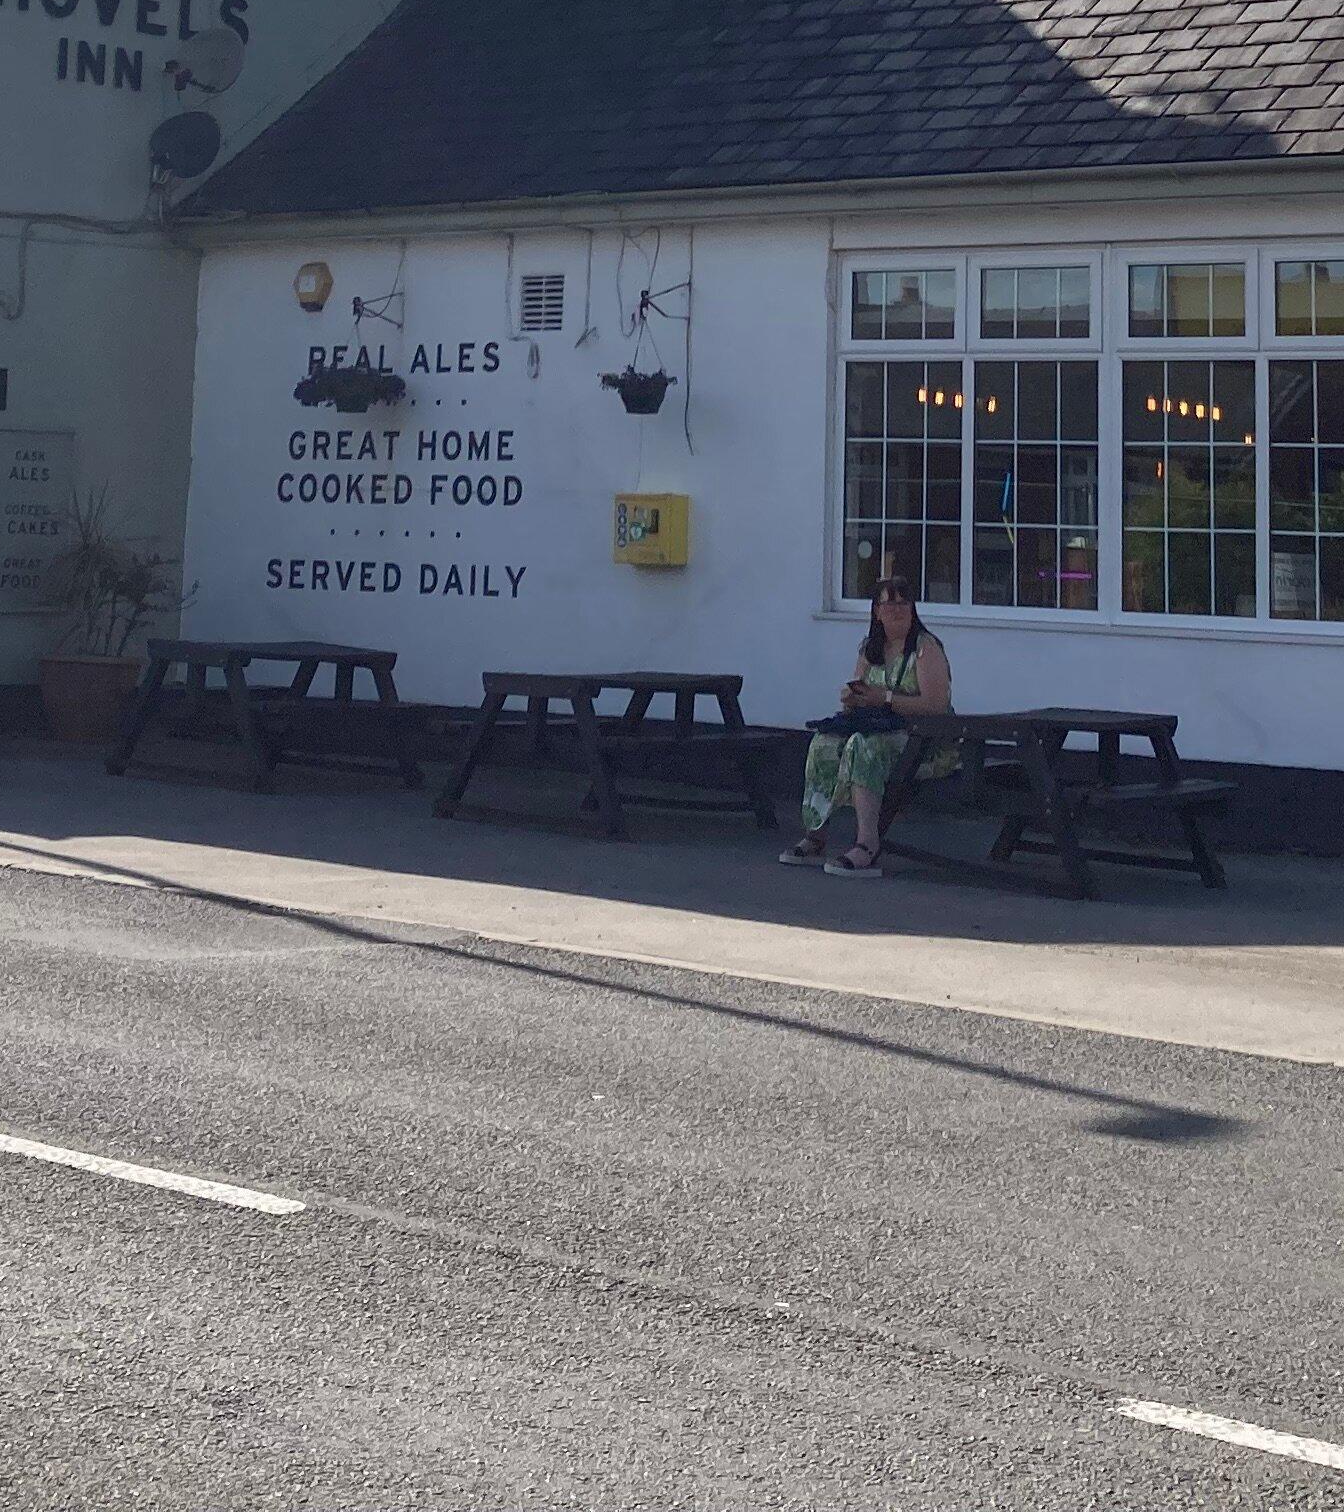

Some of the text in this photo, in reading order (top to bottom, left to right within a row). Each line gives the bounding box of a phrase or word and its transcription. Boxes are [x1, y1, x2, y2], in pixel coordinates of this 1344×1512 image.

[57, 37, 143, 91] INN
[308, 341, 501, 375] REAL ALES
[287, 430, 516, 462] GREAT HOME
[8, 466, 51, 481] ALES
[276, 472, 524, 507] COOKED FOOD
[7, 519, 60, 536] CAKES
[0, 574, 42, 589] FOOD
[266, 557, 527, 598] SERVED DAILY
